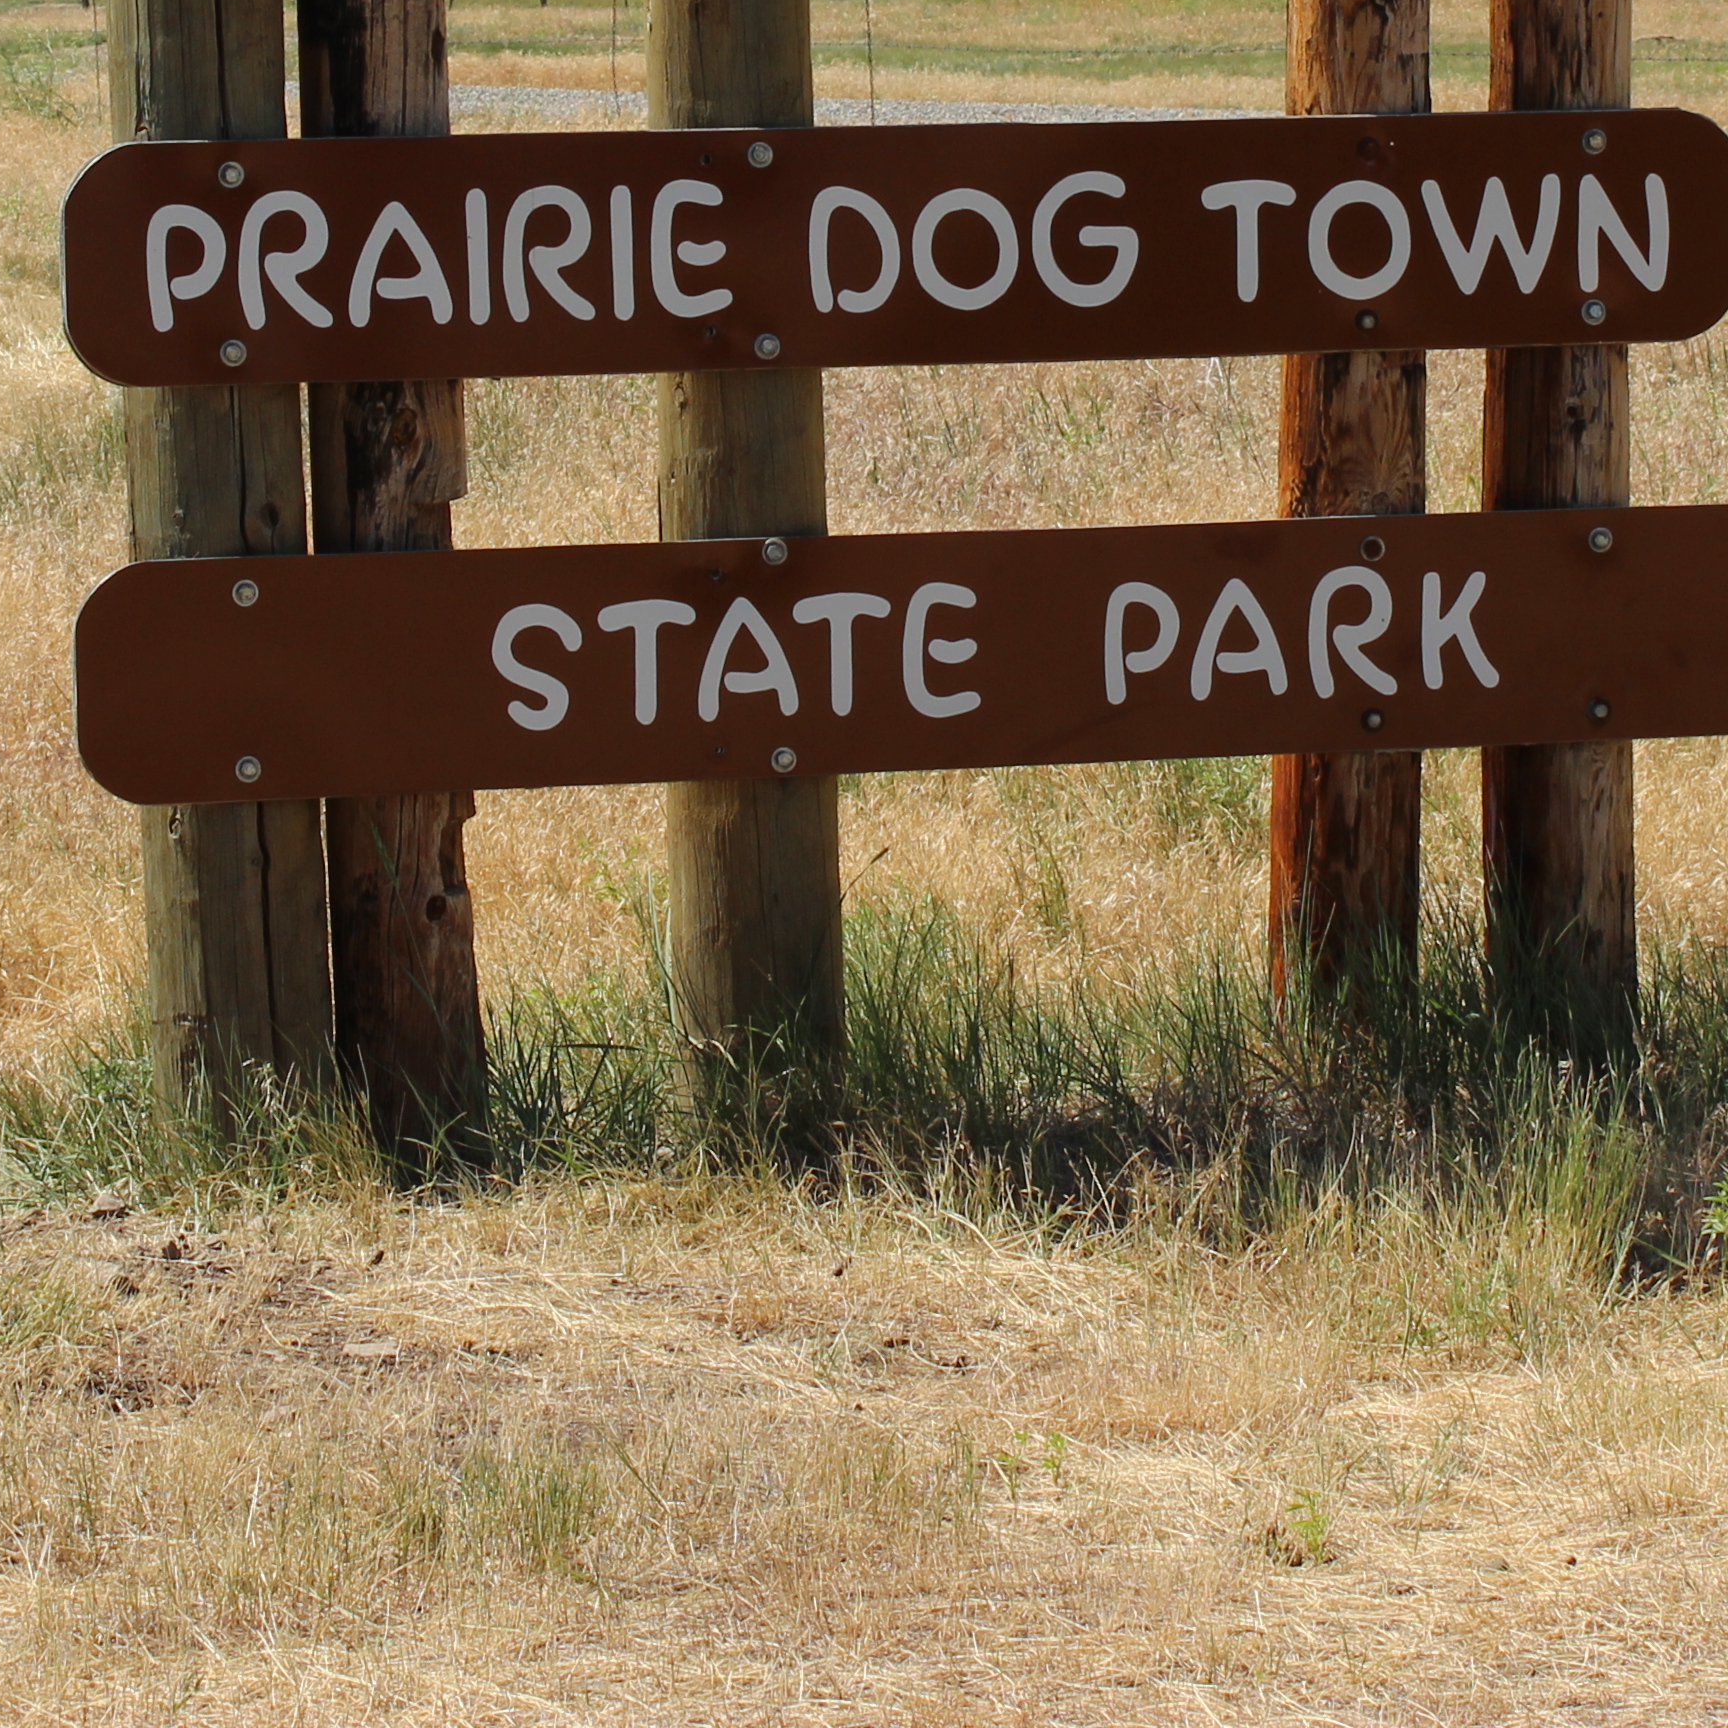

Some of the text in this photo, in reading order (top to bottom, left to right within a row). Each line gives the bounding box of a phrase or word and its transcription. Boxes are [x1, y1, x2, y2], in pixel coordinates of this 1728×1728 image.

[146, 171, 1670, 332] PRAIRIE DOG TOWN
[491, 566, 1499, 731] STATE PARK
